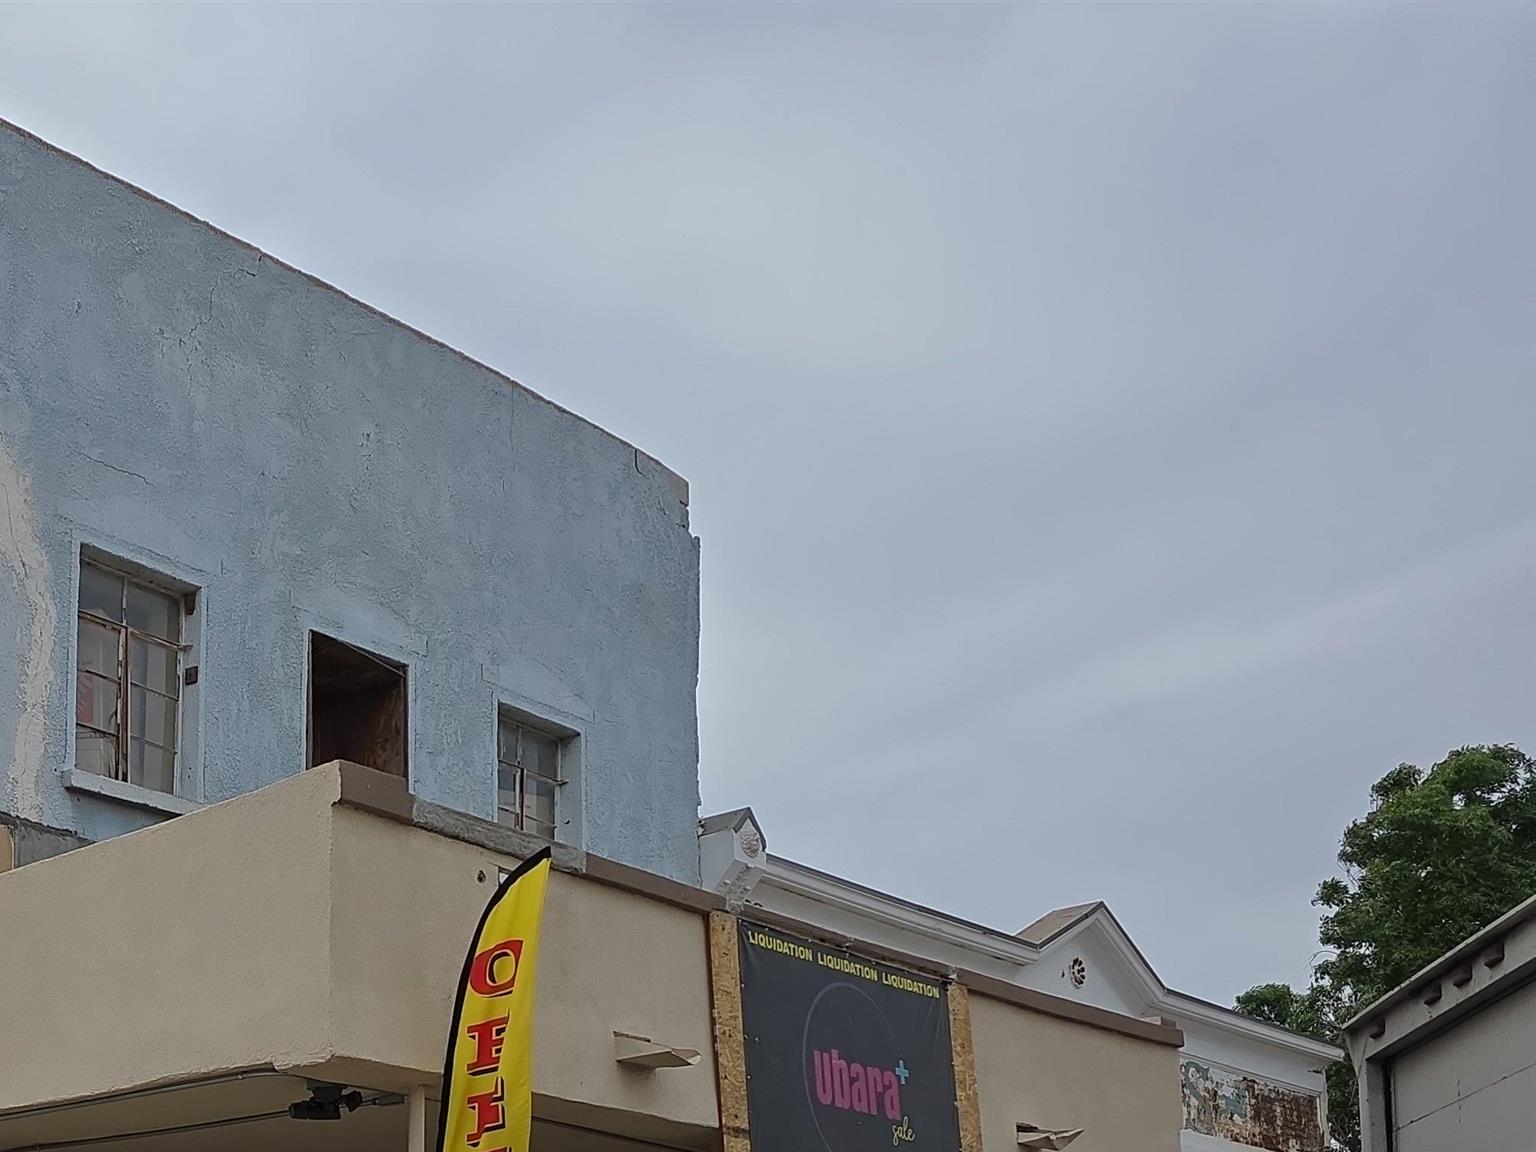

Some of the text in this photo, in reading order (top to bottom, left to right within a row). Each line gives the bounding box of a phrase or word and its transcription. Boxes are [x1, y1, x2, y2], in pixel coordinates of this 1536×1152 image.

[748, 930, 940, 999] LIQUIDATION LIQUIDATION LIQUIDATION
